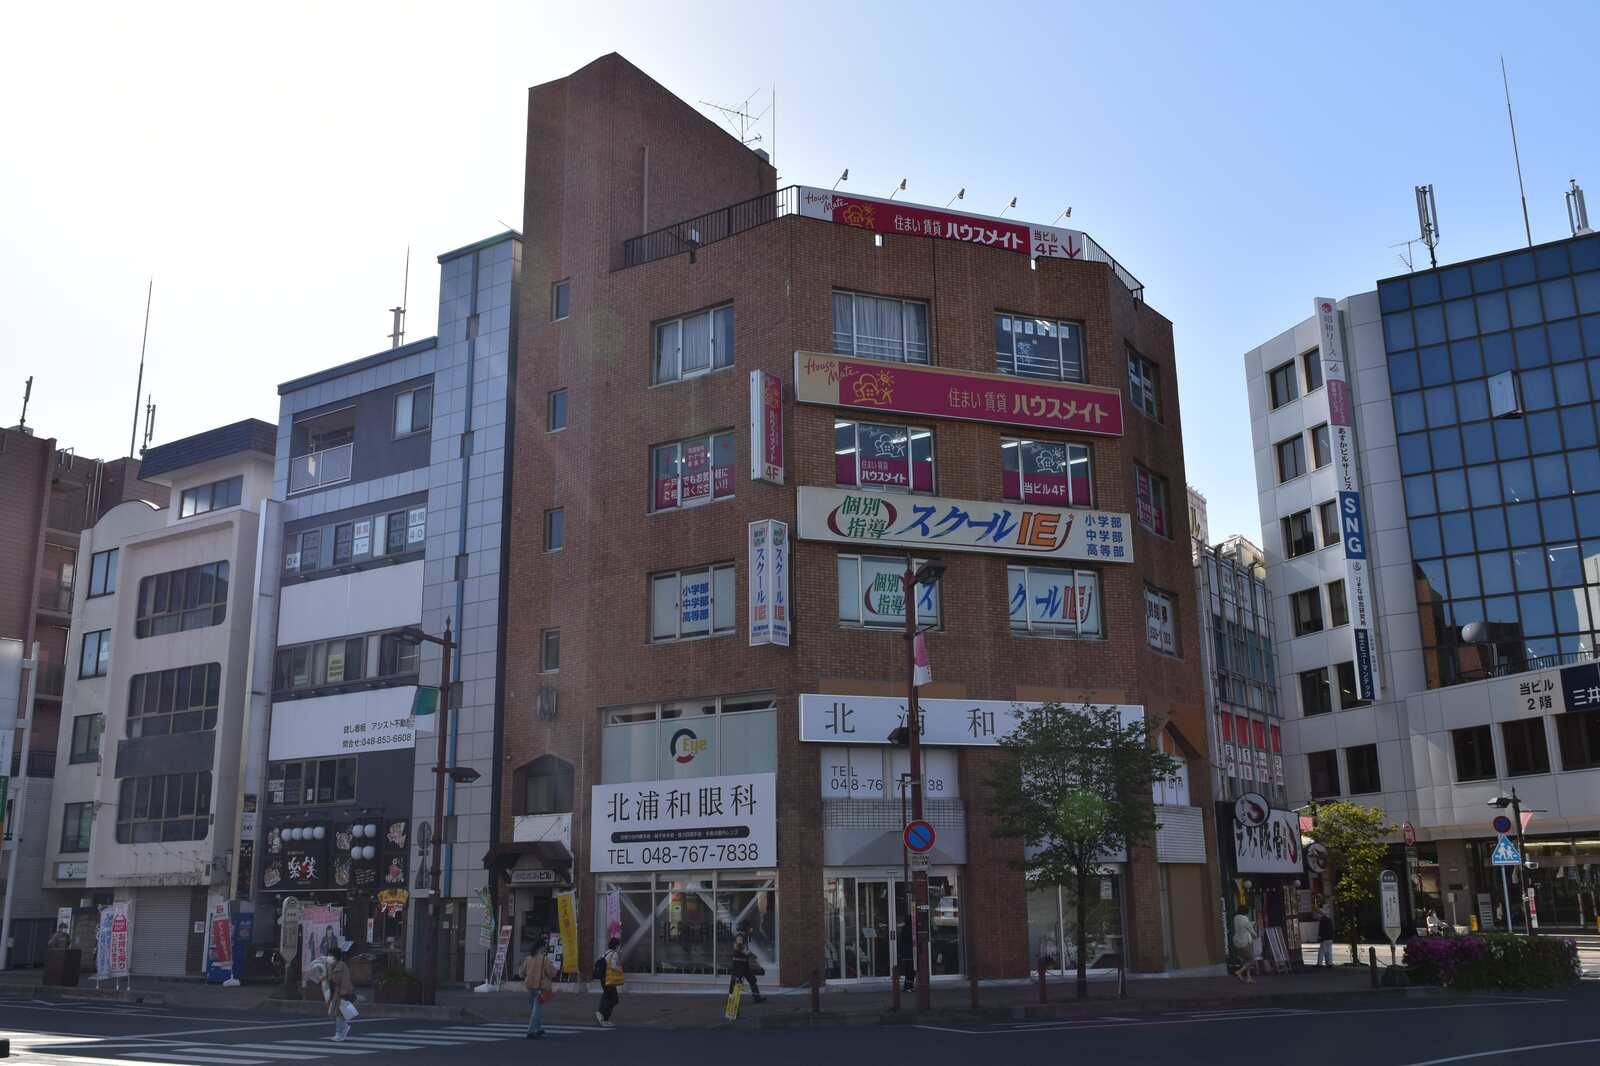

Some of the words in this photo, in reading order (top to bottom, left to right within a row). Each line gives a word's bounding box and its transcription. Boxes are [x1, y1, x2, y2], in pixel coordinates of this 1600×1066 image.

[894, 214, 921, 234] 住まい
[923, 218, 943, 237] 賃貸
[945, 221, 1024, 250] ハウスメイト
[1034, 229, 1058, 243] 当ビル
[1034, 243, 1058, 257] 4F
[948, 387, 981, 409] 住まい
[983, 390, 1009, 412] 賃貸
[1012, 394, 1109, 424] ハウスメイト
[765, 466, 779, 480] 4F
[861, 470, 907, 483] ハウスメイト
[1024, 482, 1066, 497] 当ビル4F
[841, 495, 882, 517] 個別
[848, 516, 889, 539] 指導
[1085, 514, 1122, 529] 小学部
[1345, 497, 1362, 553] SNG
[1086, 529, 1123, 543] 中学部
[1087, 543, 1124, 557] 高等部
[682, 581, 709, 596] 小学部
[874, 571, 900, 594] 個別
[682, 596, 709, 609] 中学部
[877, 594, 906, 616] 指導
[682, 609, 709, 623] 高等部
[1519, 679, 1554, 697] 当ビル
[1527, 696, 1553, 711] 2階
[831, 765, 859, 777] TEL
[607, 783, 757, 823] 北浦和眼科
[607, 849, 634, 865] TEL
[642, 843, 759, 865] 048-767-7838
